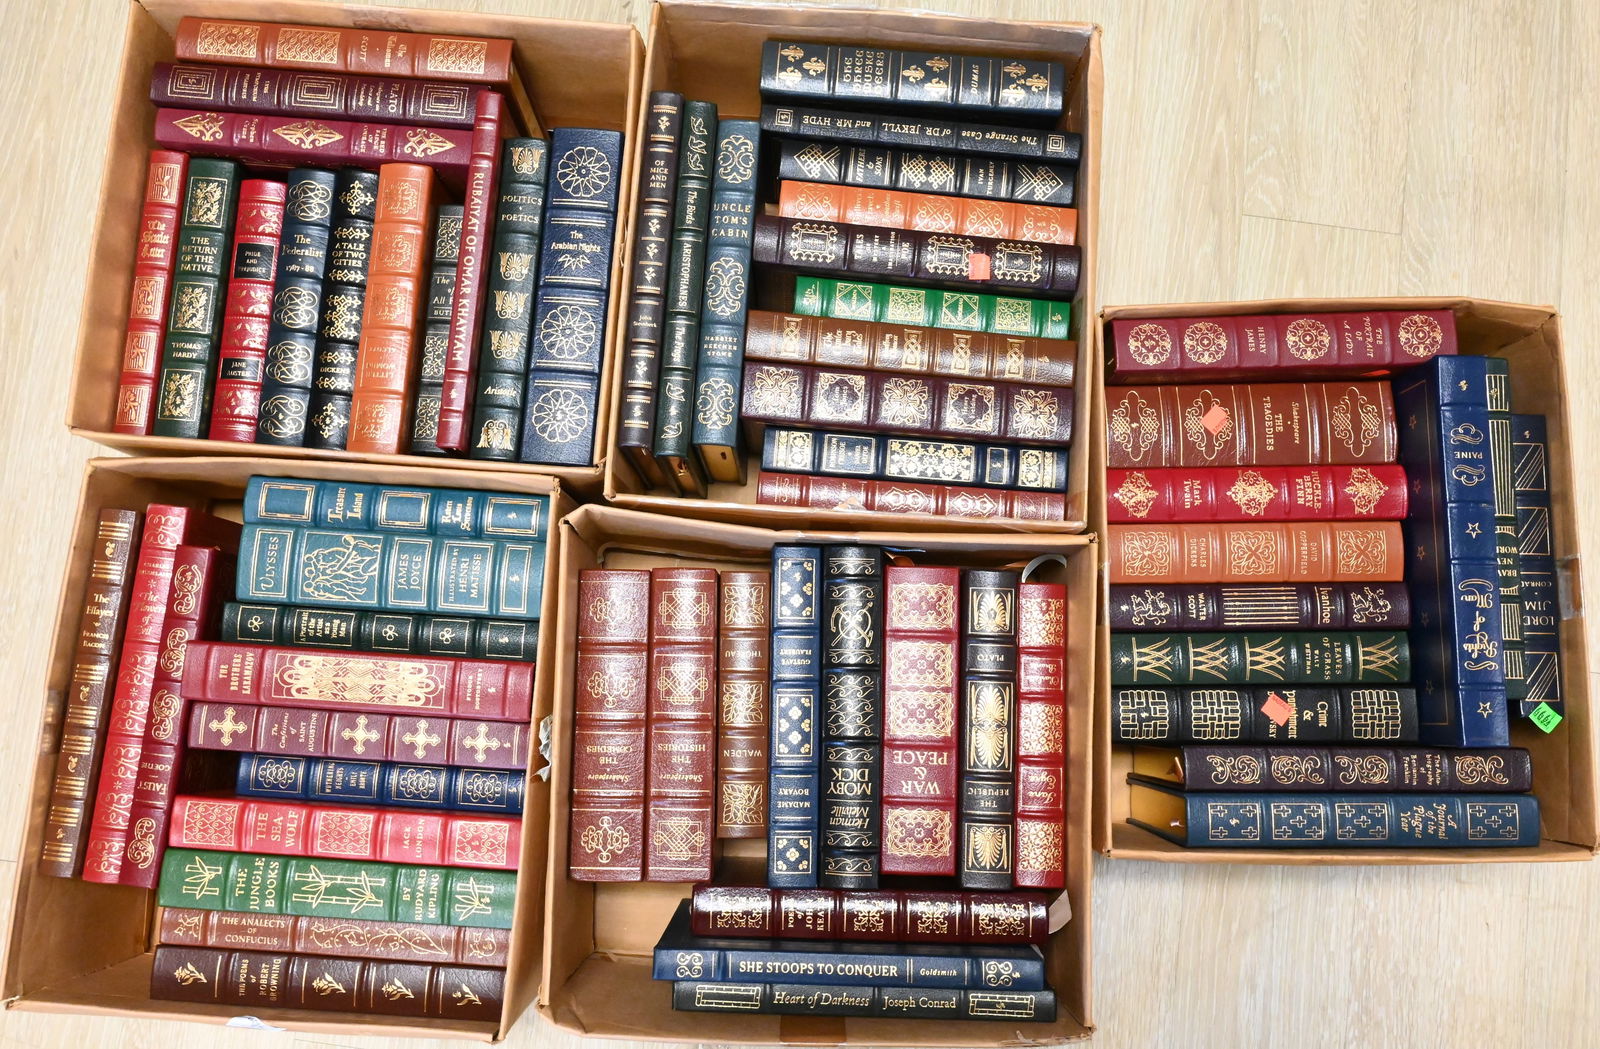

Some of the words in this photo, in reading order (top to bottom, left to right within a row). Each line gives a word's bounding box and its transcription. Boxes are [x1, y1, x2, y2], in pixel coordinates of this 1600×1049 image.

[359, 36, 369, 63] SCOTT
[971, 64, 979, 95] DUMAS
[388, 84, 401, 113] PLATO
[803, 115, 832, 127] HYDE
[835, 117, 853, 129] MR.
[855, 120, 873, 130] and
[881, 122, 921, 136] JEKYLL
[924, 126, 941, 138] DR.
[941, 128, 952, 138] of
[961, 130, 984, 143] Case
[985, 130, 1019, 145] Strange
[1021, 135, 1038, 147] The
[650, 167, 669, 175] MICE
[874, 156, 883, 176] SONS
[977, 168, 985, 185] IVAN
[649, 180, 666, 189] MEN
[503, 194, 543, 205] POLITICS
[687, 190, 698, 204] The
[685, 205, 697, 225] Birds
[713, 201, 751, 214] UNCLE
[501, 212, 539, 224] POETICS
[714, 214, 748, 226] TOM'S
[294, 233, 311, 245] The
[569, 231, 584, 239] The
[711, 226, 748, 239] CABIN
[191, 236, 210, 245] THE
[343, 242, 364, 251] TALE
[855, 233, 865, 260] TALES
[183, 245, 218, 256] RETURN
[282, 244, 323, 258] Federalist
[332, 250, 345, 260] OF
[346, 250, 366, 260] TWO
[901, 242, 910, 260] POE
[180, 263, 213, 273] NATIVE
[181, 255, 194, 266] OF
[198, 255, 214, 265] THE
[332, 258, 362, 267] CITIES
[677, 242, 693, 308] ARISTOPHANES
[1245, 328, 1255, 353] JAMES
[1258, 326, 1267, 355] HENRY
[1355, 330, 1362, 340] OF
[1362, 316, 1376, 358] PORTRAIT
[1376, 328, 1384, 345] THE
[171, 342, 201, 350] THOMAS
[173, 350, 198, 359] HARDY
[319, 366, 350, 375] DICKENS
[484, 385, 517, 397] Aristotle
[1262, 396, 1276, 452] TRAGEDIES
[1274, 413, 1284, 432] THE
[1453, 451, 1483, 459] PAINE
[1183, 479, 1192, 509] Twain
[1192, 479, 1202, 506] Mark
[1295, 478, 1305, 505] FINN
[1303, 475, 1313, 509] BERRY
[327, 487, 346, 523] Treasure
[347, 492, 364, 519] Island
[1189, 538, 1197, 568] DICKENS
[1199, 537, 1207, 568] CHARLES
[1299, 530, 1308, 575] COPPERFIELD
[1310, 541, 1318, 562] DAVID
[260, 535, 279, 591] ULYSSES
[396, 553, 408, 590] JAMES
[410, 554, 423, 590] JOYCE
[458, 558, 470, 592] HENRI
[470, 553, 482, 598] MATISSE
[93, 593, 110, 604] The
[1319, 587, 1333, 624] Ivanhoe
[1524, 600, 1552, 611] JIM
[1188, 594, 1197, 619] SCOTT
[1196, 592, 1206, 621] WALTER
[1473, 610, 1486, 632] of
[83, 630, 110, 640] FRANCIS
[330, 619, 341, 639] Young
[83, 640, 106, 649] BACON
[1322, 636, 1331, 647] OF
[724, 650, 762, 659] THOREAU
[779, 648, 812, 656] FLAUBERT
[976, 653, 1005, 662] PLATO
[1304, 642, 1312, 675] WHITMAN
[1333, 641, 1342, 675] LEAVES
[780, 658, 811, 666] GUSTAVE
[1323, 649, 1332, 681] GRASS
[219, 663, 228, 679] THE
[230, 653, 243, 694] BROTHERS
[241, 651, 255, 695] KARAMAZOV
[1303, 709, 1314, 721] &
[1316, 701, 1329, 728] Crime
[271, 722, 279, 737] The
[279, 712, 289, 750] Confessions
[298, 721, 308, 743] SAINT
[308, 712, 319, 752] AUGUSTINE
[586, 744, 633, 754] COMEDIES
[657, 743, 706, 754] HISTORIES
[723, 748, 762, 758] WALDEN
[599, 756, 618, 765] THE
[671, 755, 691, 764] THE
[892, 750, 949, 765] PEACE
[587, 772, 629, 783] Shakespeare
[659, 772, 703, 783] Shakespeare
[831, 767, 869, 782] DICK
[912, 766, 927, 779] &
[1402, 756, 1411, 784] Franklin
[1410, 754, 1419, 786] Benjamin
[1425, 754, 1434, 786] biography
[900, 780, 941, 795] WAR
[1027, 774, 1057, 786] Eyre
[138, 781, 167, 795] FAUST
[777, 787, 810, 796] BOVARY
[827, 781, 872, 795] MOBY
[967, 787, 1010, 797] REPUBLIC
[776, 800, 811, 809] MADAME
[979, 799, 998, 808] THE
[1027, 789, 1056, 805] Jane
[829, 804, 870, 819] Melville
[256, 811, 268, 841] THE
[285, 809, 299, 848] WOLF
[828, 815, 870, 829] Herman
[1400, 811, 1412, 833] Year
[1411, 805, 1425, 839] Plague
[1432, 803, 1448, 840] Journal
[1447, 814, 1457, 830] A
[402, 826, 410, 849] JACK
[416, 821, 425, 858] LONDON
[235, 867, 248, 897] THE
[250, 857, 264, 910] JUNGLE
[265, 861, 279, 909] BOOKS
[402, 887, 411, 902] BY
[414, 869, 427, 920] RUDYARD
[428, 873, 439, 919] KIPLING
[221, 916, 240, 927] THE
[240, 917, 286, 929] ANALECTS
[224, 932, 279, 945] CONFUCIUS
[739, 960, 765, 973] SHE
[766, 961, 814, 976] STOOPS
[816, 963, 835, 975] TO
[836, 963, 899, 979] CONQUER
[919, 967, 957, 978] Goldsmith
[249, 974, 257, 983] of
[259, 962, 270, 996] ROBERT
[270, 958, 282, 1001] BROWNING
[773, 990, 807, 1005] Heart
[807, 991, 820, 1006] of
[820, 991, 871, 1008] Darkness
[883, 995, 916, 1011] Joseph
[916, 995, 956, 1009] Conrad
